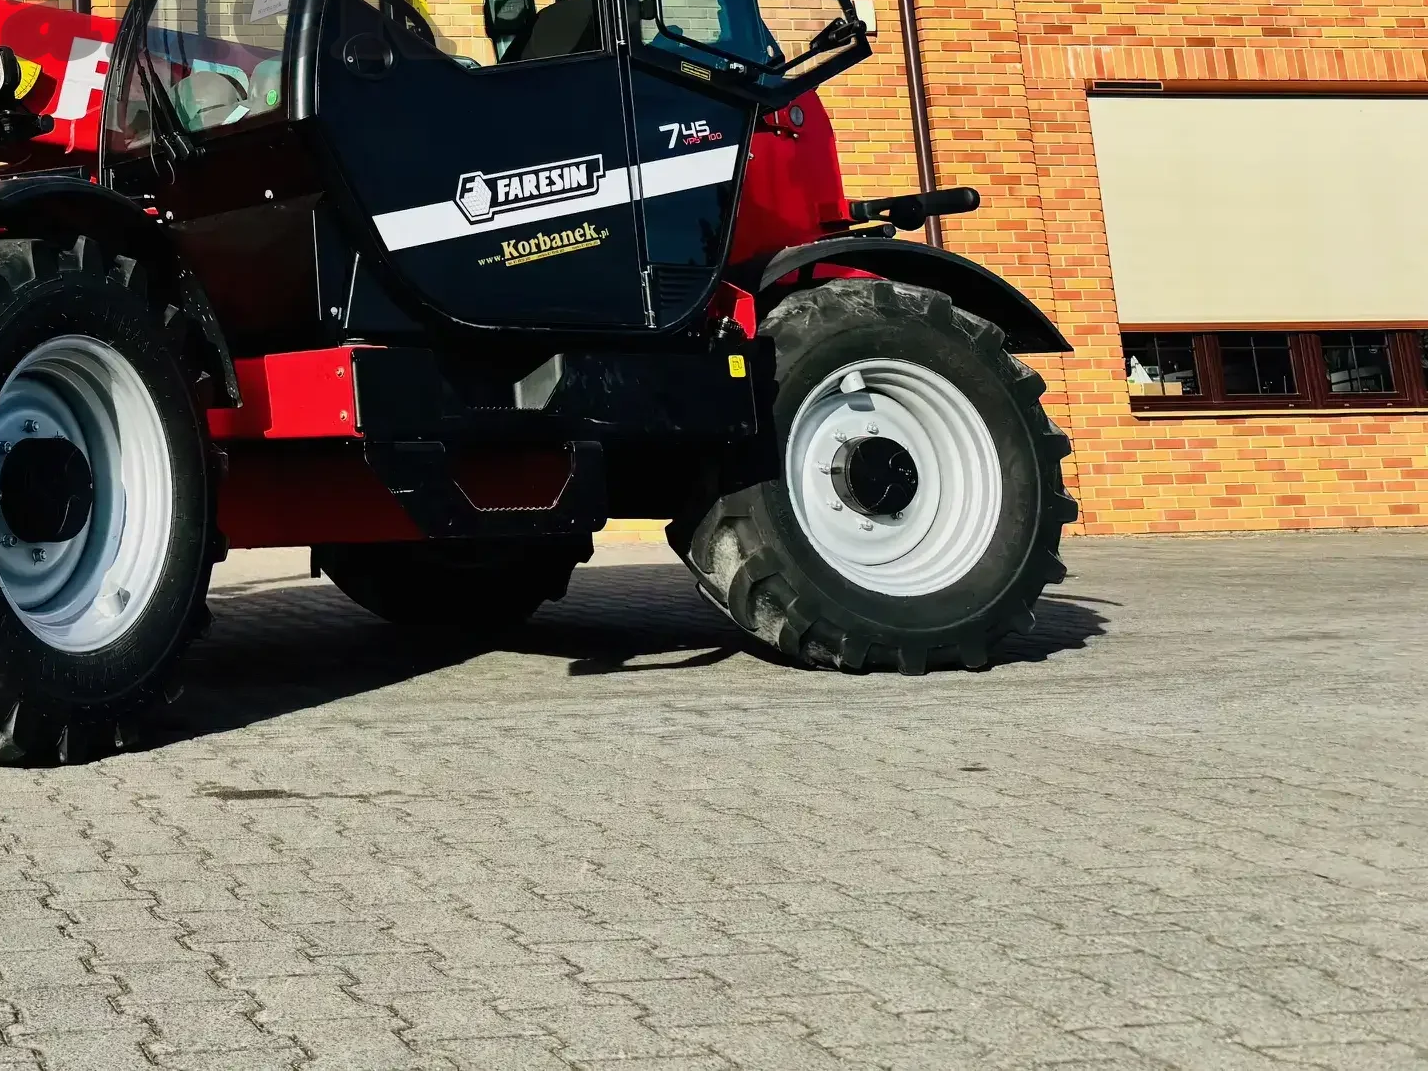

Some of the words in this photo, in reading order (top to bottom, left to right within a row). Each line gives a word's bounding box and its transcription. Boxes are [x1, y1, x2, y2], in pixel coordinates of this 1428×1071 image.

[658, 119, 710, 149] 745
[497, 163, 588, 203] FARESIN
[477, 222, 609, 266] www.Korbanek.pl
